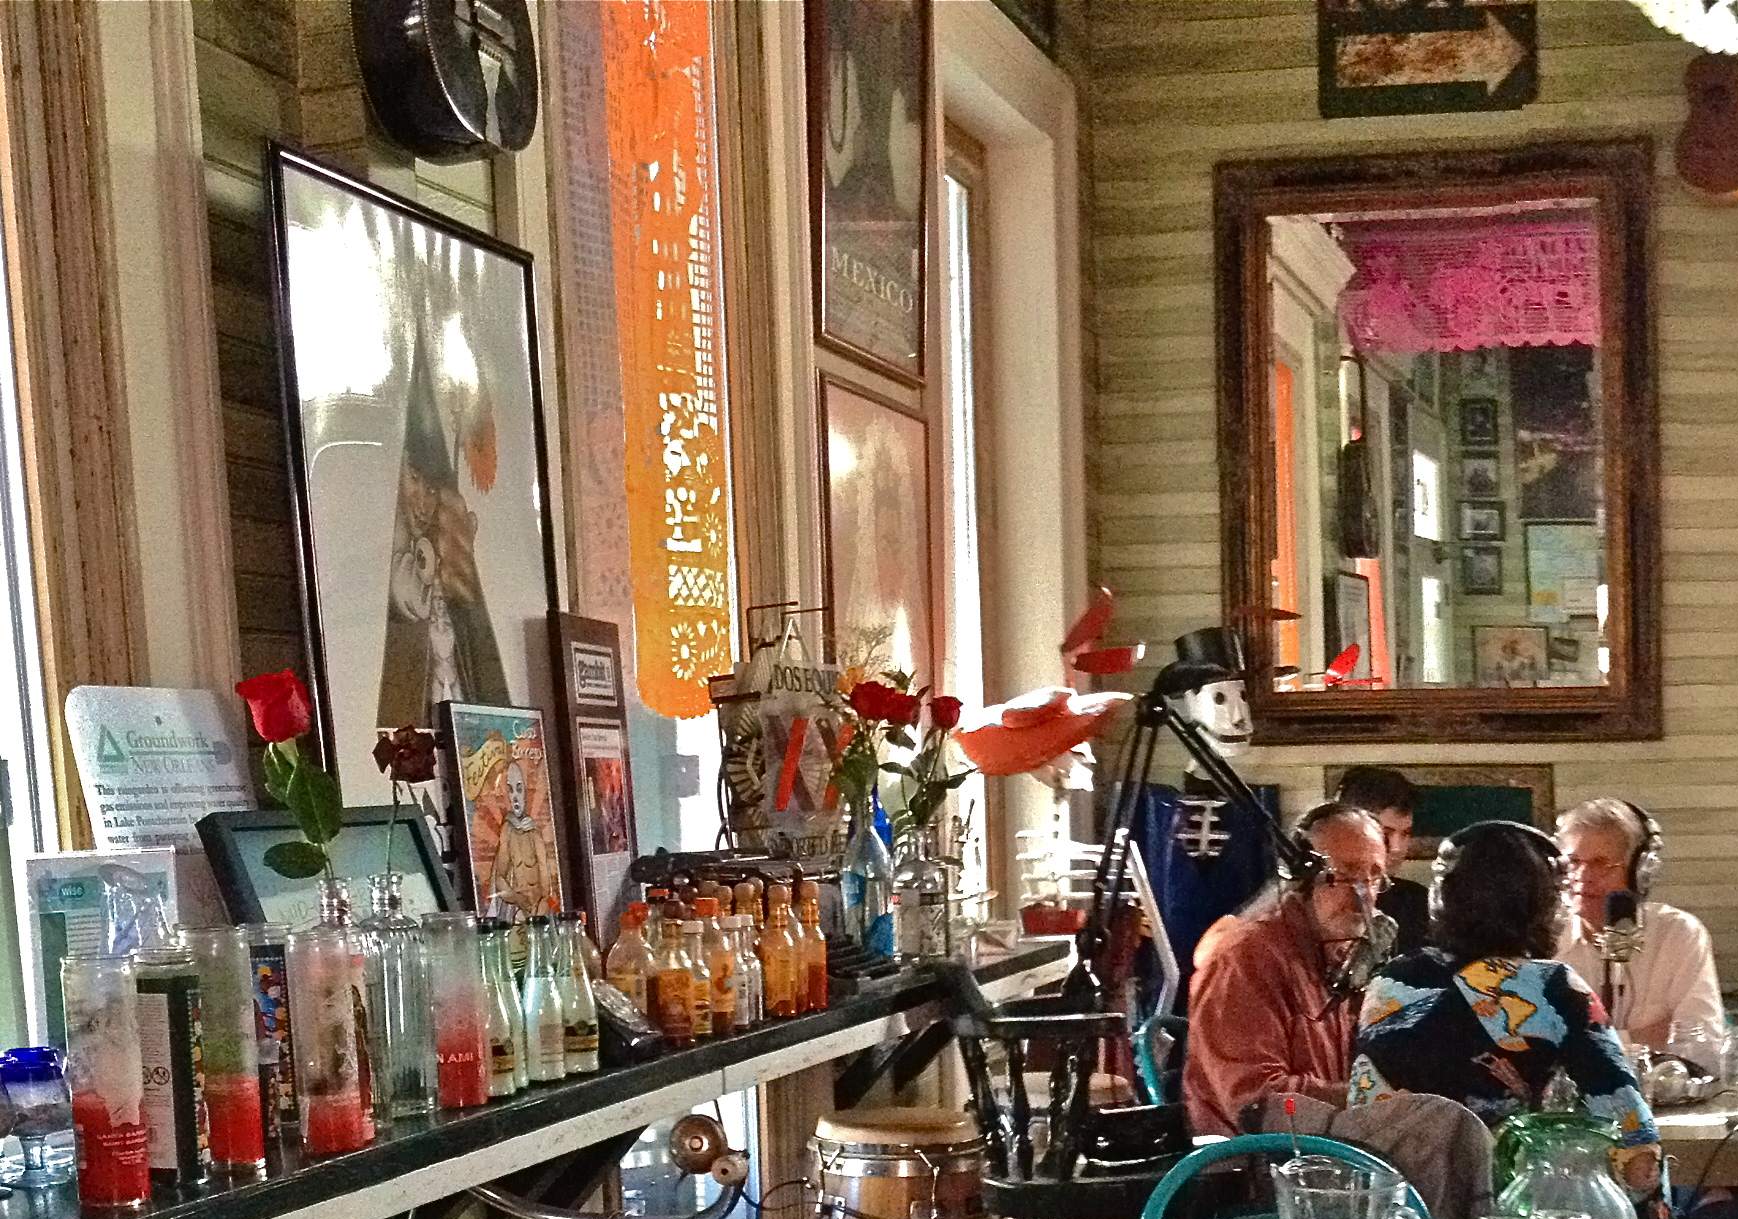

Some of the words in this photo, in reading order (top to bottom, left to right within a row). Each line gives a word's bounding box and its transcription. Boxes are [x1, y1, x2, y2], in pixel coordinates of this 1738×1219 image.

[832, 246, 913, 313] MEXICO
[773, 664, 802, 692] DOS
[802, 668, 840, 696] EQUI
[126, 731, 209, 749] Groundwork
[95, 784, 114, 795] This
[100, 804, 113, 816] gas
[115, 803, 152, 811] emissions
[155, 800, 168, 810] and
[104, 818, 112, 827] in
[115, 817, 134, 827] Lake
[108, 836, 129, 844] water
